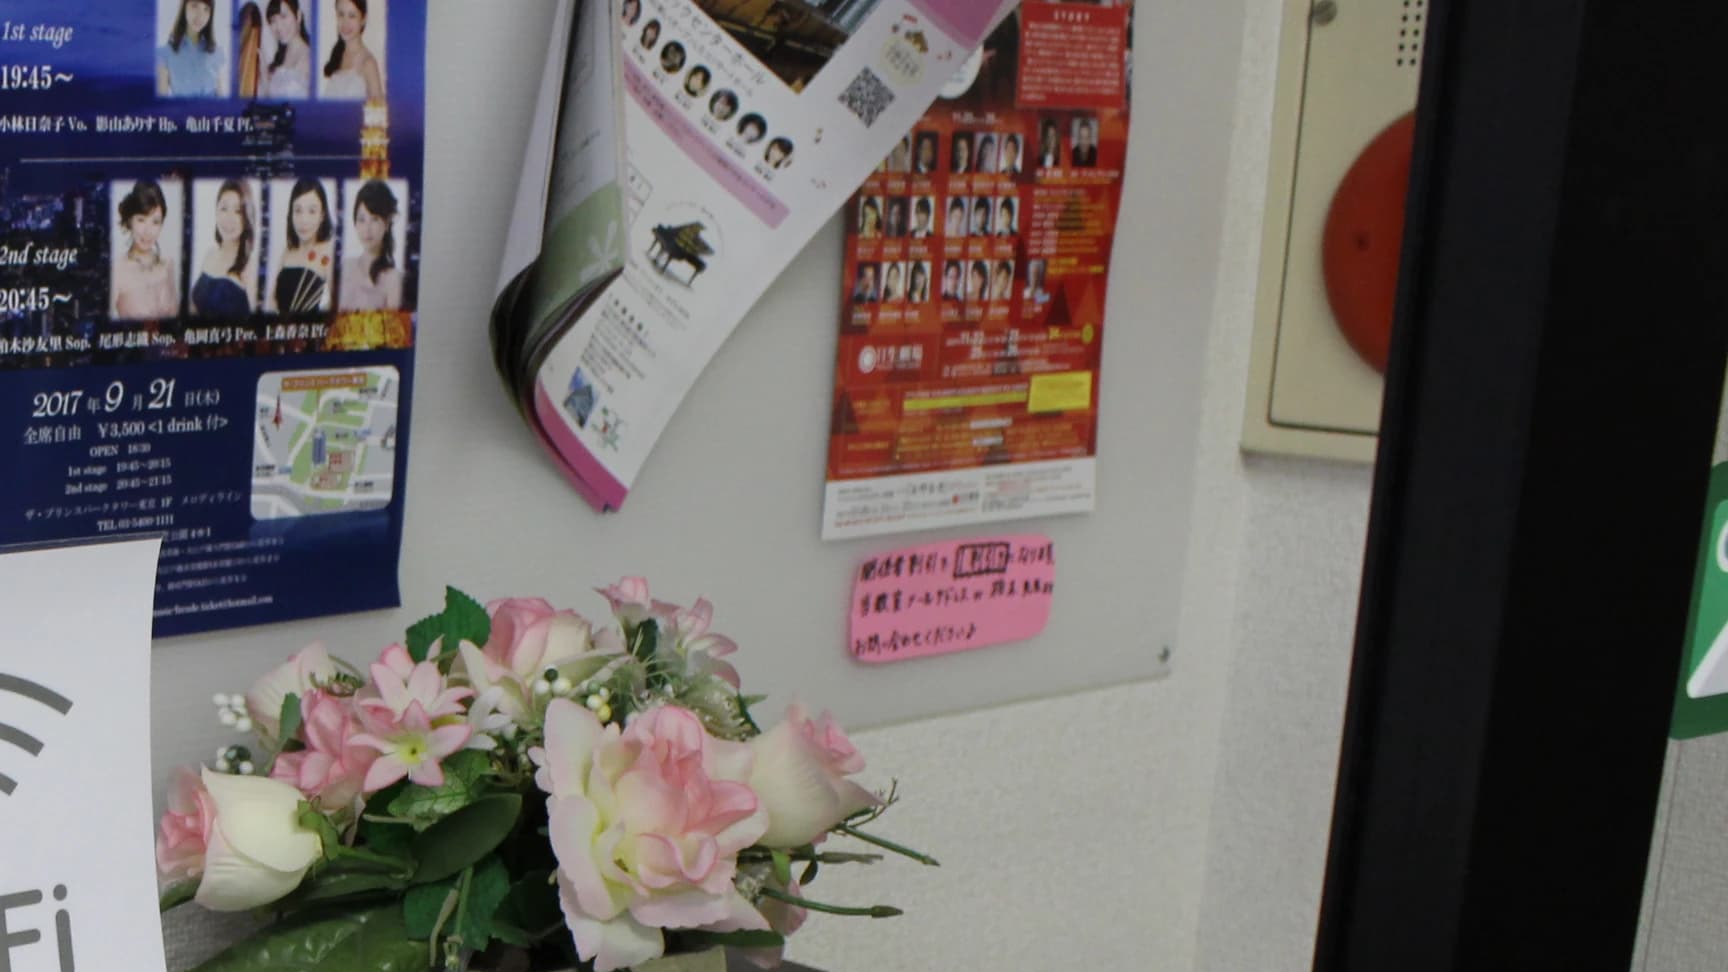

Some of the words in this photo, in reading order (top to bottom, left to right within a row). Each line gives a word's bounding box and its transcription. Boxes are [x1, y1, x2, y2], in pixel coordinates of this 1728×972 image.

[2, 20, 26, 42] 1st
[30, 23, 74, 43] stage
[33, 245, 79, 270] stage
[32, 389, 84, 418] 2017
[87, 396, 101, 415] 年
[104, 380, 125, 413] 9
[133, 394, 144, 411] 月
[148, 377, 176, 409] 21
[24, 425, 82, 445] 全席自由
[167, 416, 203, 434] drink
[89, 444, 120, 458] OPEN
[83, 463, 108, 477] stage
[84, 481, 109, 495] stage
